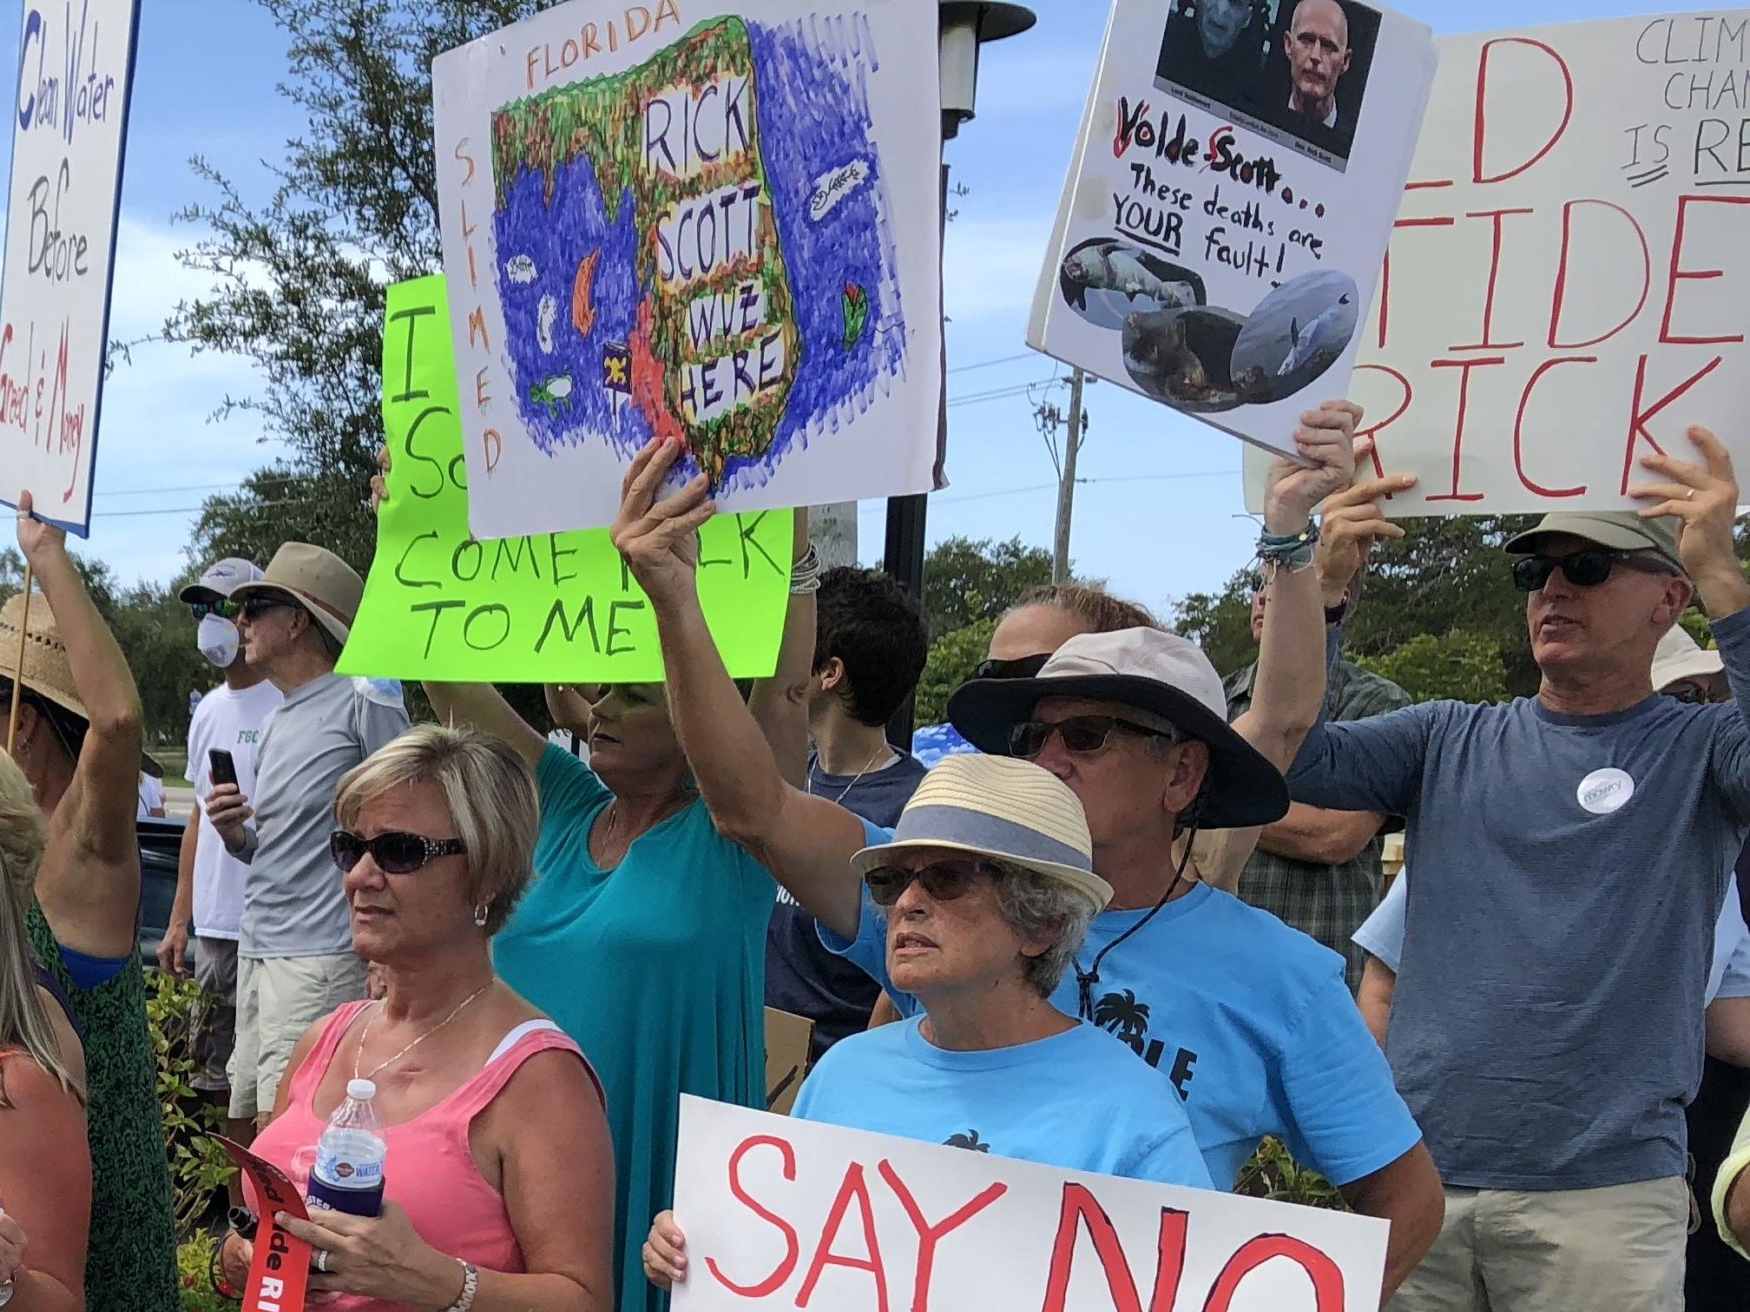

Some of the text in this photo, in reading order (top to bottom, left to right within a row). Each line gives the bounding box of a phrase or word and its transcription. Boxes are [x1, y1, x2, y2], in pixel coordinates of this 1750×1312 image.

[18, 0, 115, 147] Clean Water
[524, 3, 682, 90] FLORIDA
[645, 76, 752, 176] RICK
[1620, 122, 1672, 169] IS
[27, 156, 88, 287] Before
[654, 183, 763, 282] SCOTT
[1113, 192, 1287, 291] YOUR fault!
[1130, 162, 1323, 260] These deaths are
[1377, 195, 1746, 350] TIDE
[389, 305, 437, 403] I
[678, 330, 784, 414] HERE
[45, 313, 86, 504] Money
[1348, 354, 1725, 503] RICK
[394, 526, 579, 589] COME
[410, 594, 646, 661] TO ME
[355, 1164, 381, 1178] WATER
